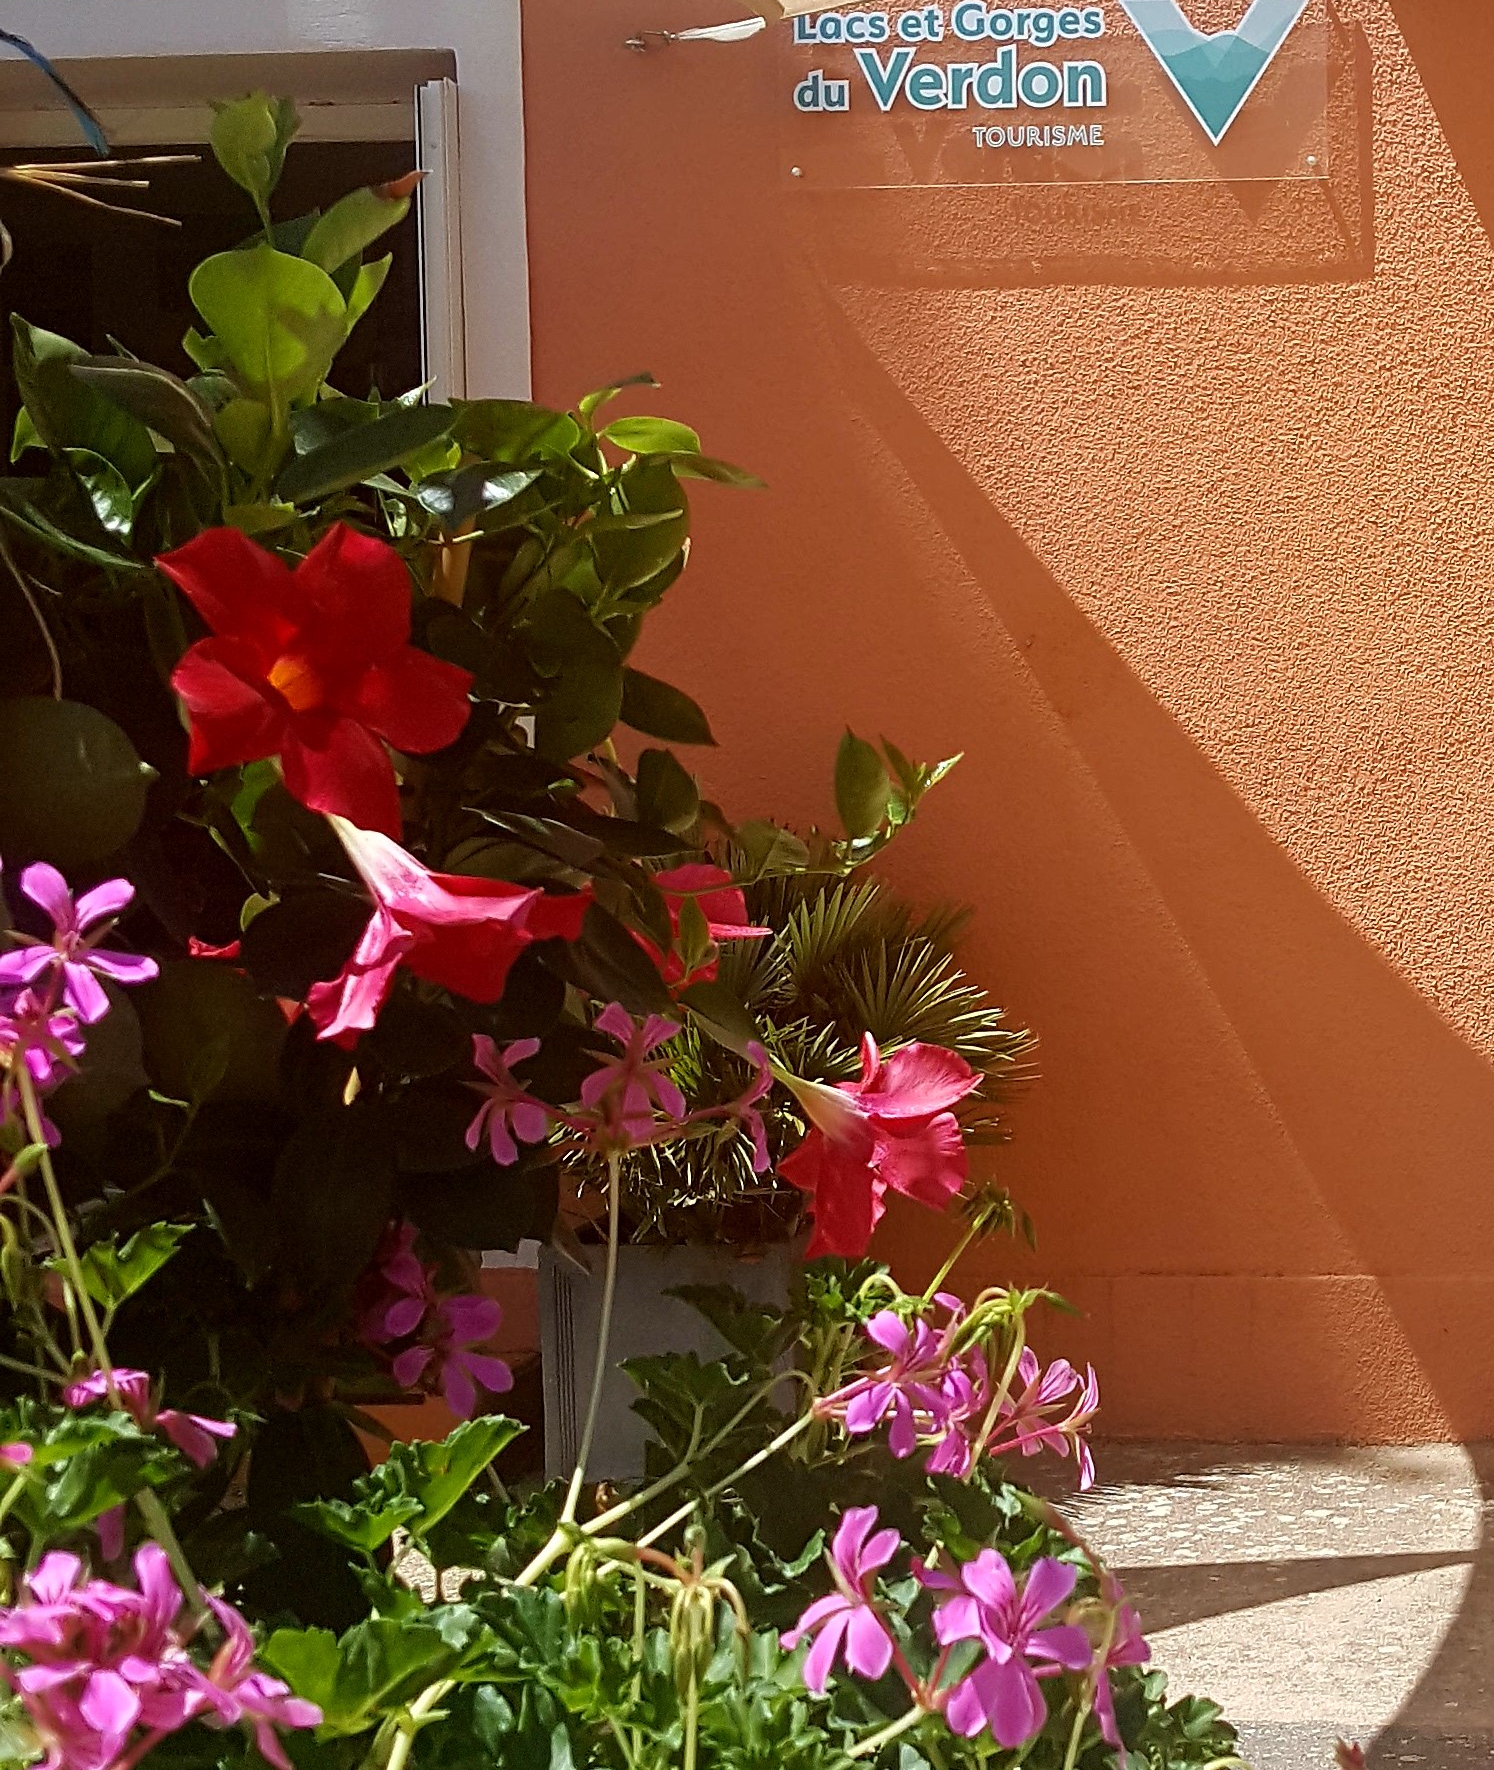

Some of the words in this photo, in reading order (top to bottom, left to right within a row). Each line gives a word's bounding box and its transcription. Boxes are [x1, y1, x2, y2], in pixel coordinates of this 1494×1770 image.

[795, 12, 890, 43] Lacs
[898, 5, 944, 41] et
[953, 0, 1105, 46] Gorges
[795, 71, 848, 111] du
[855, 46, 1107, 111] Verdon
[972, 125, 1105, 148] TOURISME
